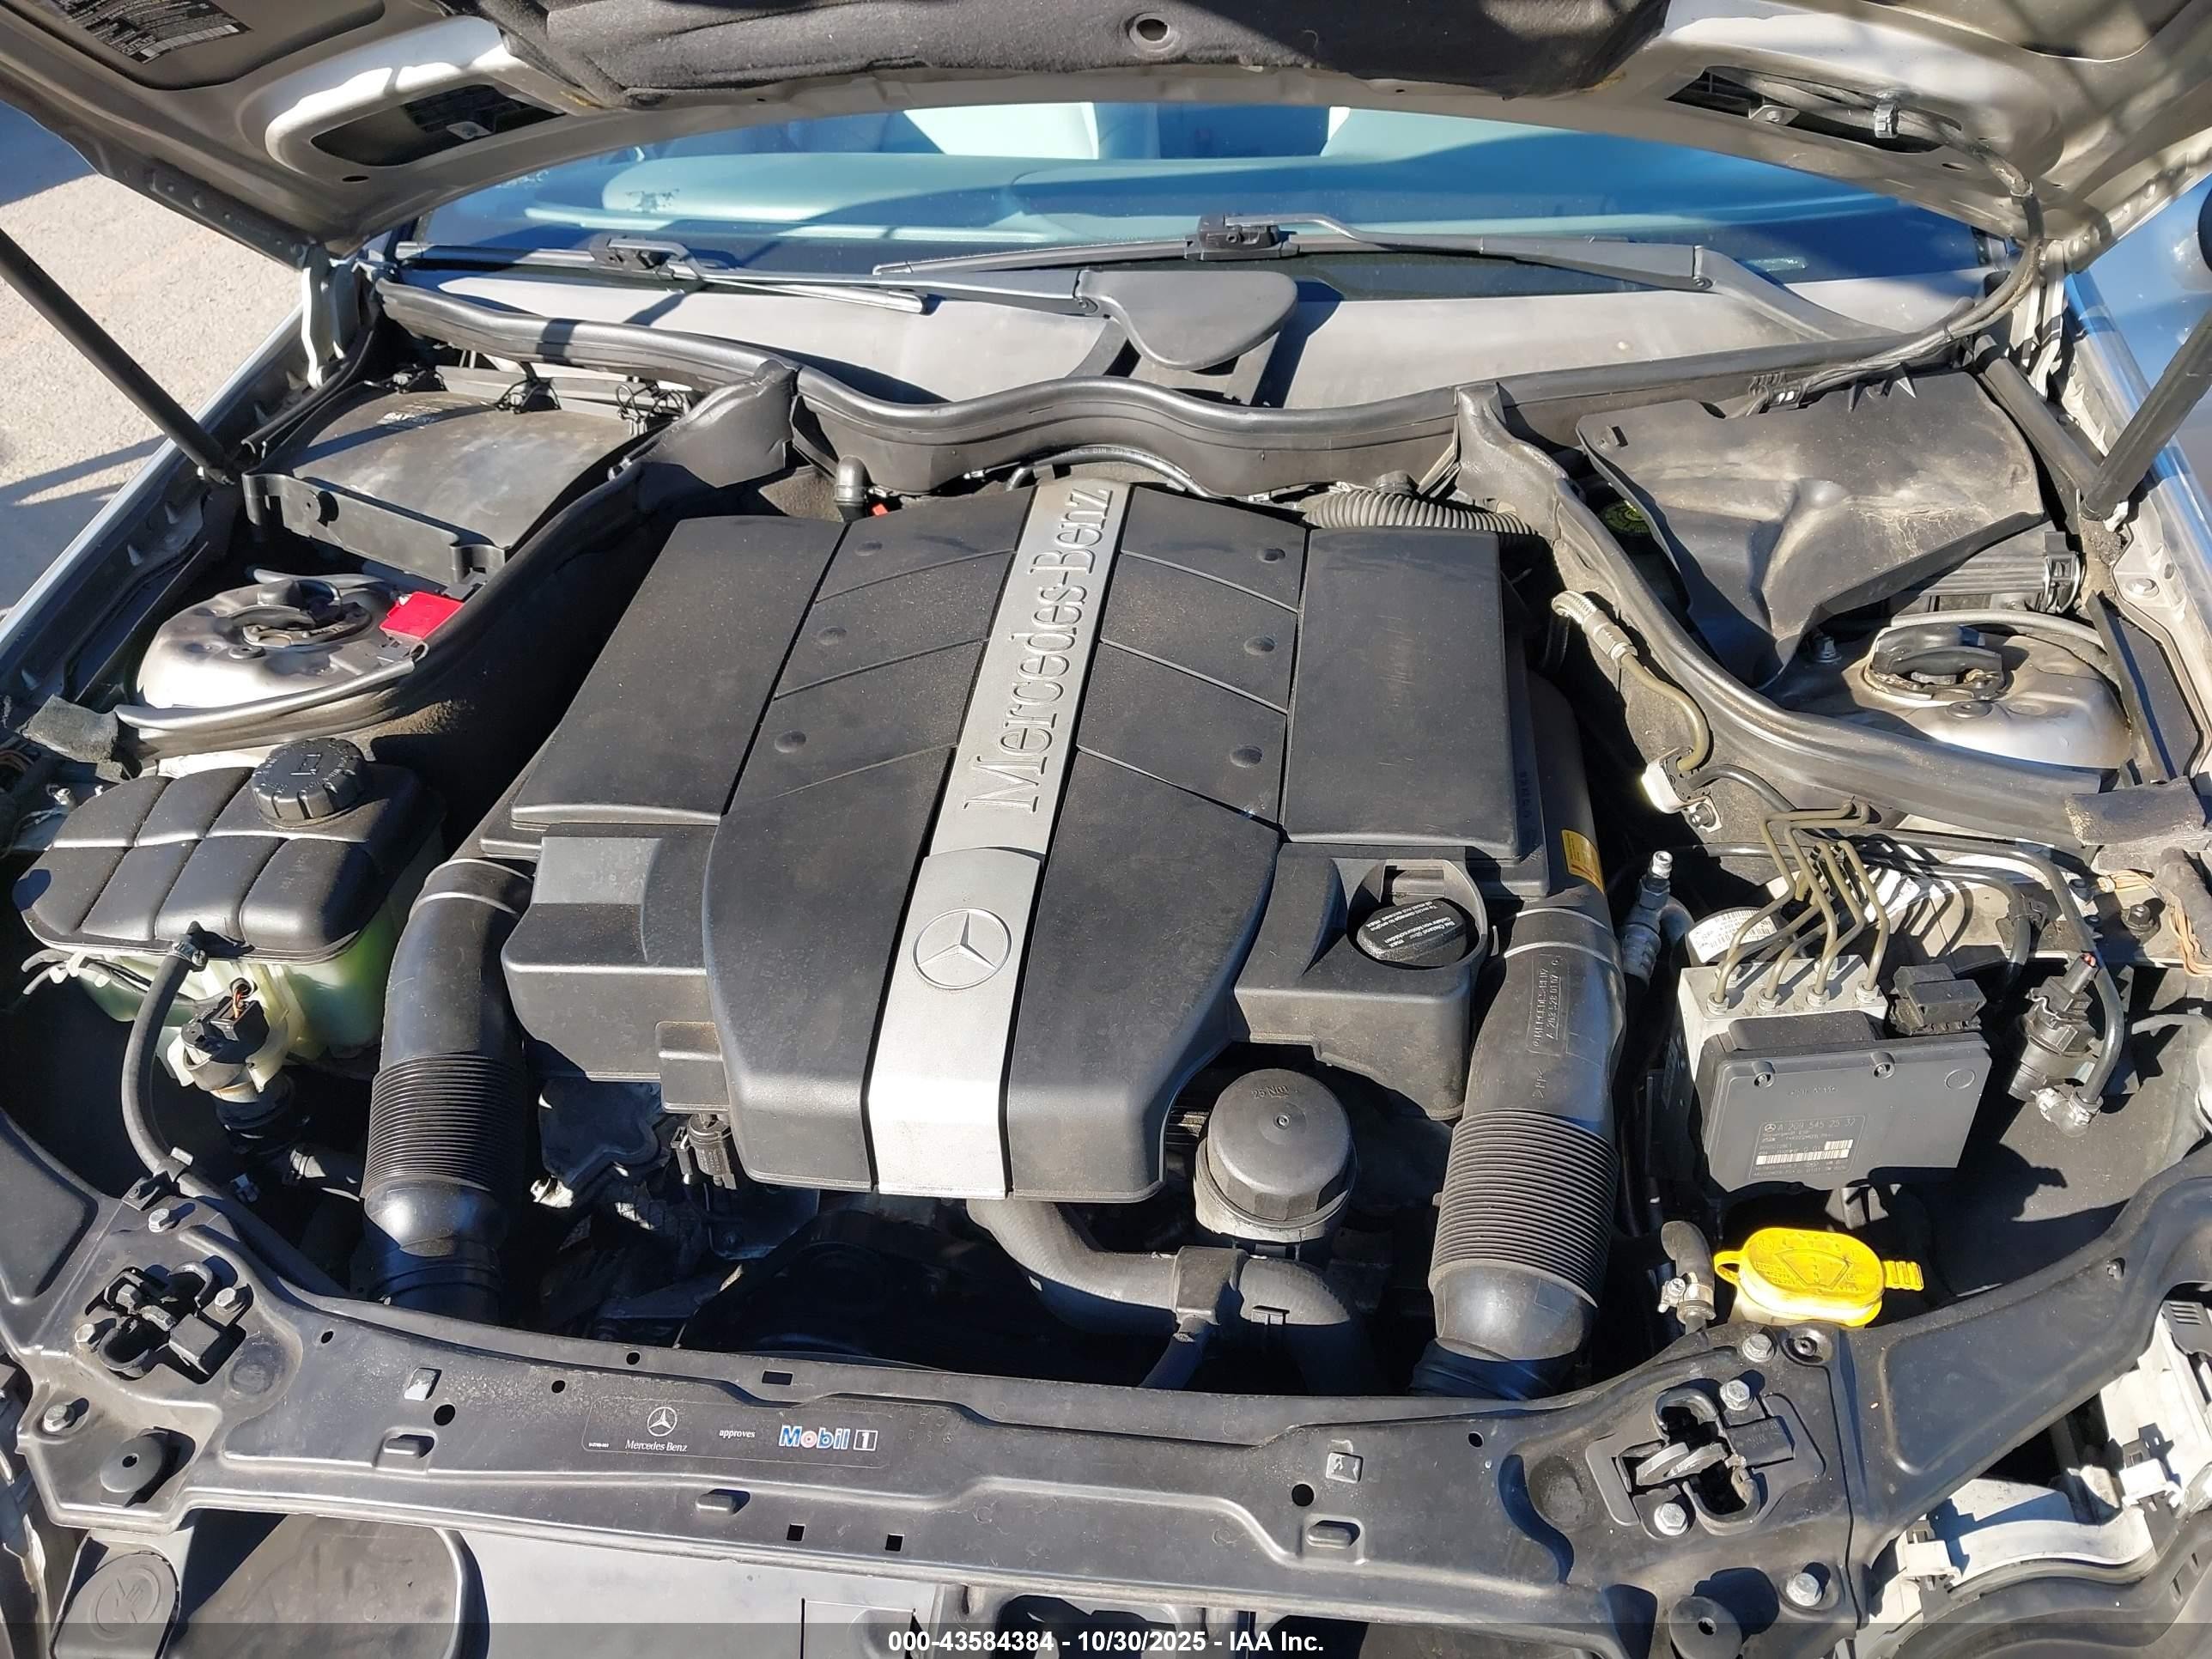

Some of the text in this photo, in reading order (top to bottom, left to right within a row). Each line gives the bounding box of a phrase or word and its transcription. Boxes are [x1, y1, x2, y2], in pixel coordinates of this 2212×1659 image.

[963, 488, 1113, 814] Mercedes-Benz
[1389, 939, 1405, 948] max
[1267, 1085, 1289, 1096] Nm
[719, 1428, 756, 1439] approves
[778, 1425, 850, 1450] Mobil
